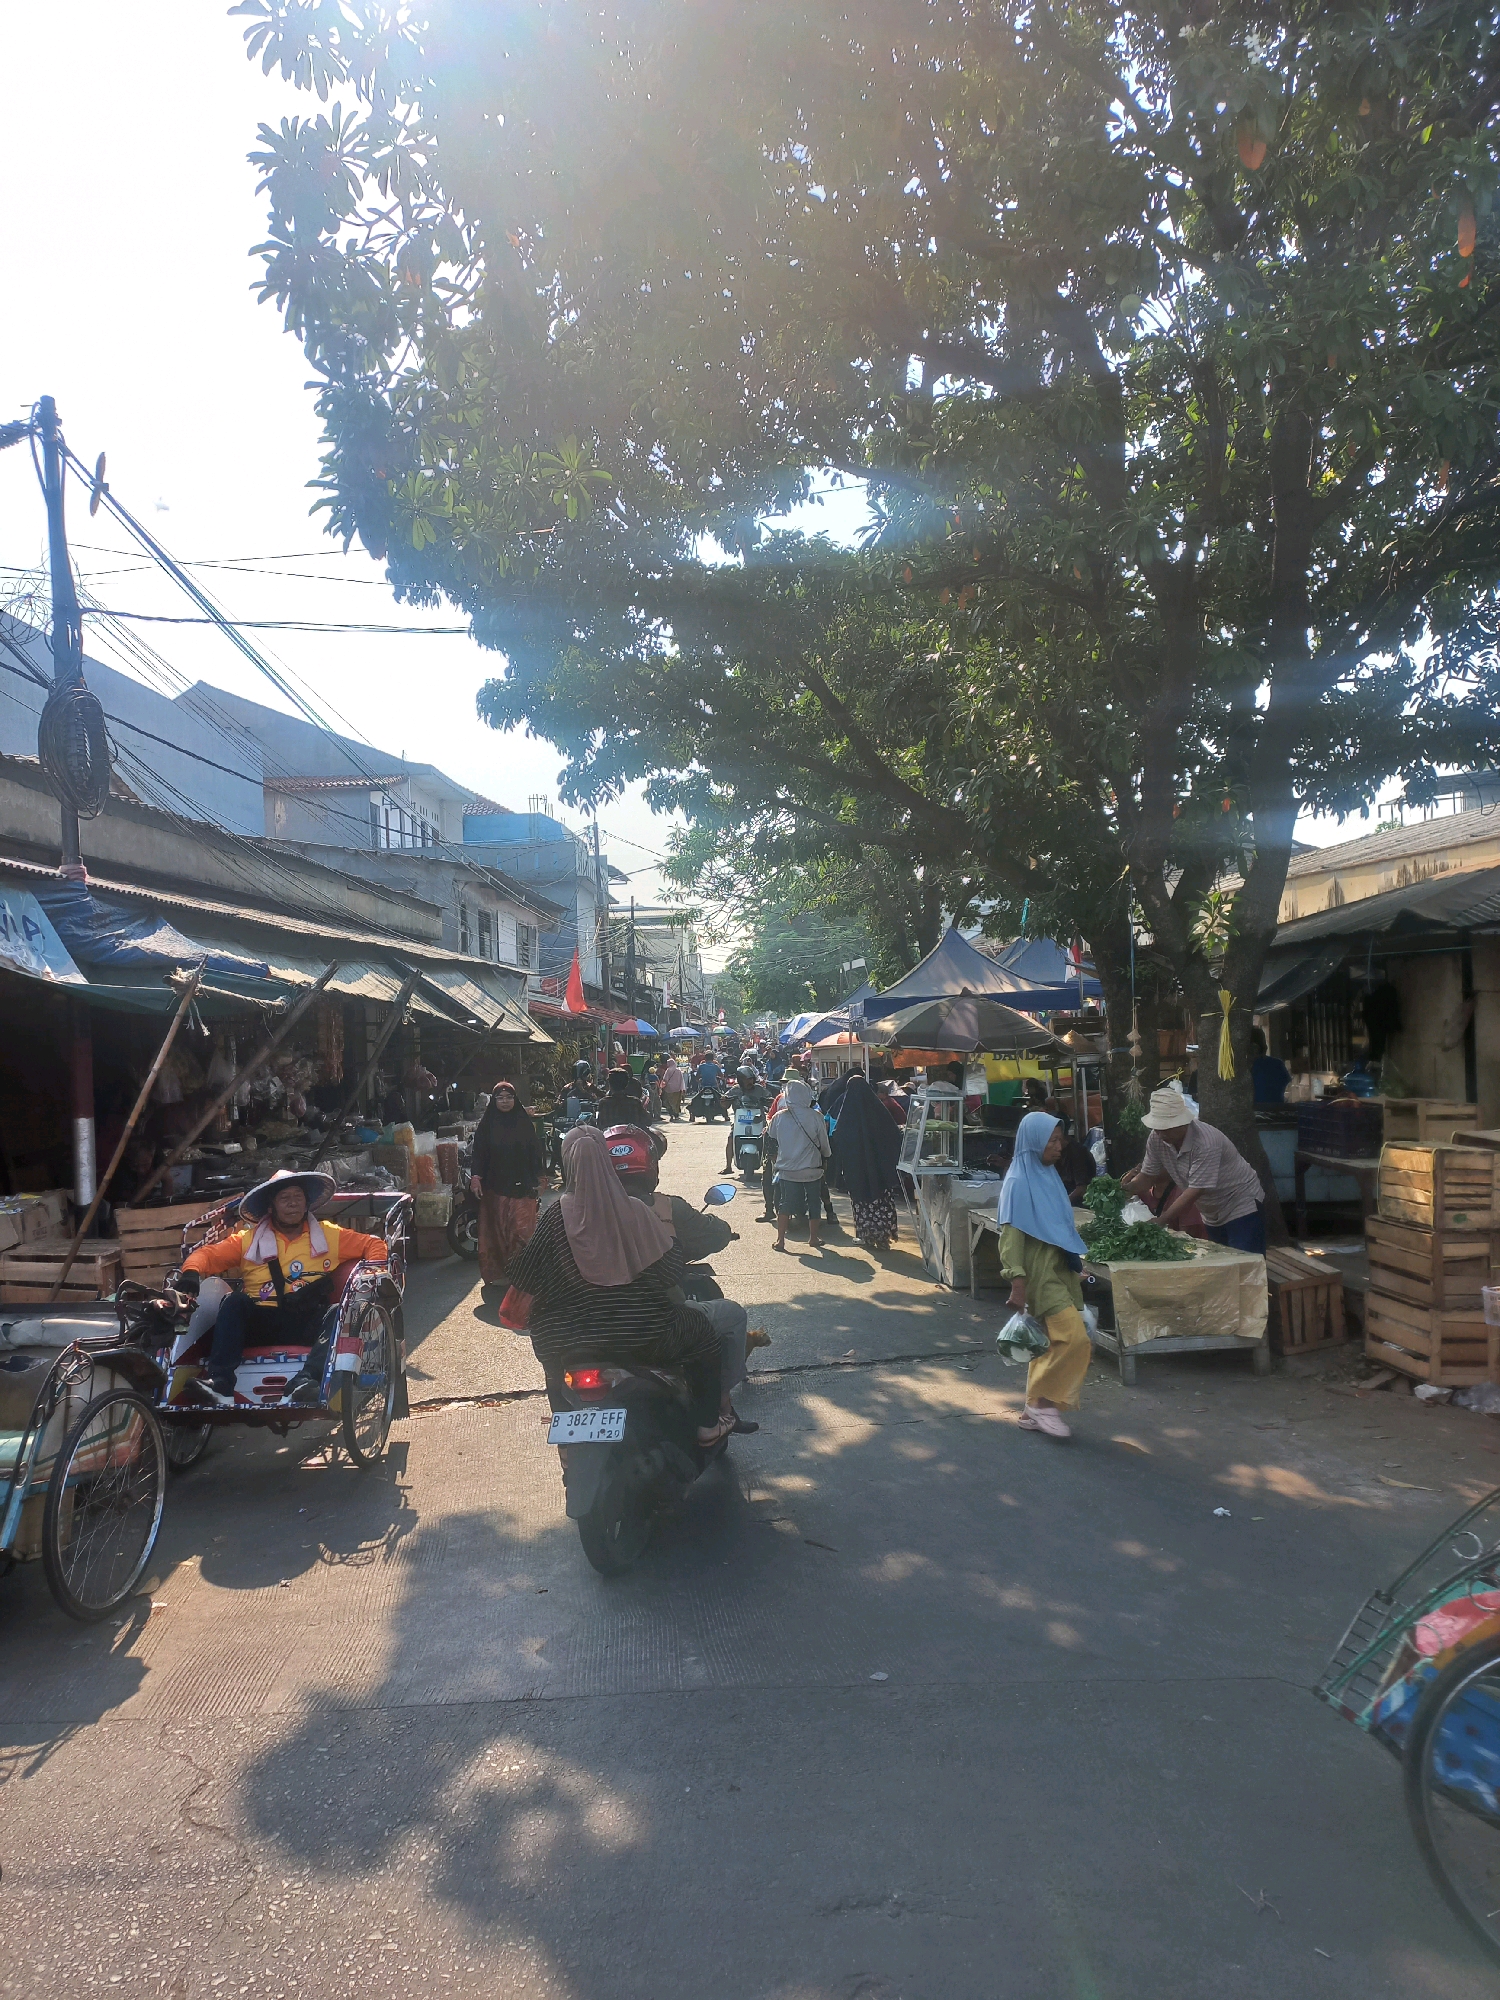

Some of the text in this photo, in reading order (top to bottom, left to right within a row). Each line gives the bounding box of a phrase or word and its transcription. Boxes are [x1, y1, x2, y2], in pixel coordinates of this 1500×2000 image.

[552, 1412, 624, 1427] B 3827 EFF
